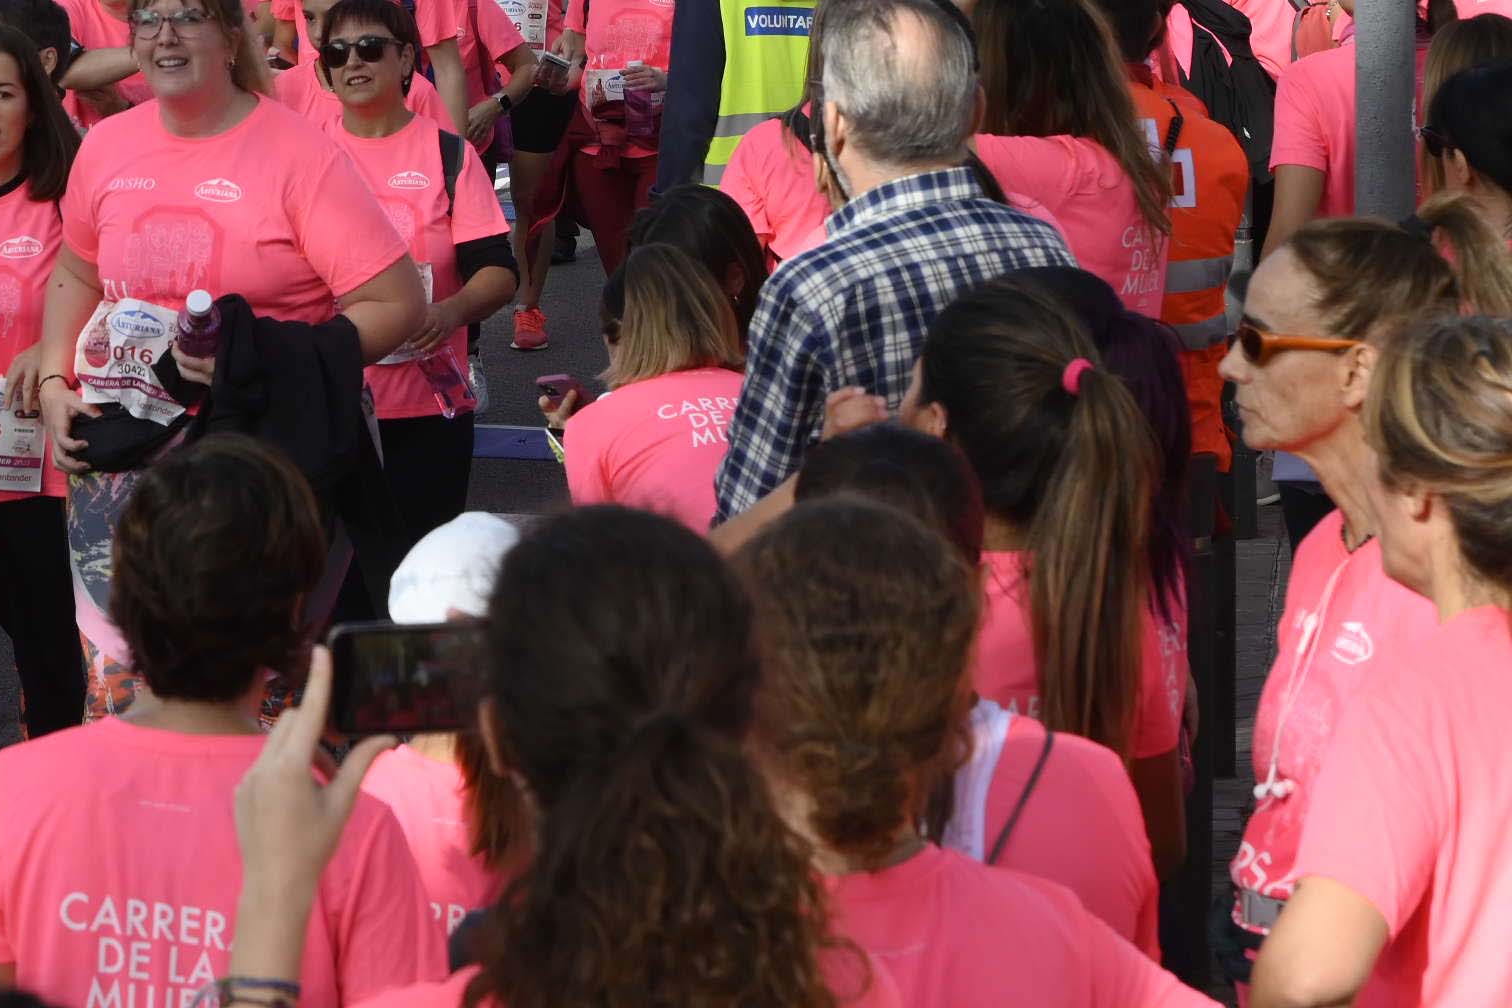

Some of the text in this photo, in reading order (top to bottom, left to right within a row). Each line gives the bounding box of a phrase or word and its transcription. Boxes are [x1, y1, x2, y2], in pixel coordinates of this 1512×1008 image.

[197, 185, 242, 200] ASTURIANA
[1, 244, 40, 254] ASTURIANA
[113, 345, 153, 365] 016
[689, 410, 727, 429] DE
[59, 891, 237, 949] CARRER
[98, 937, 215, 984] DE LA
